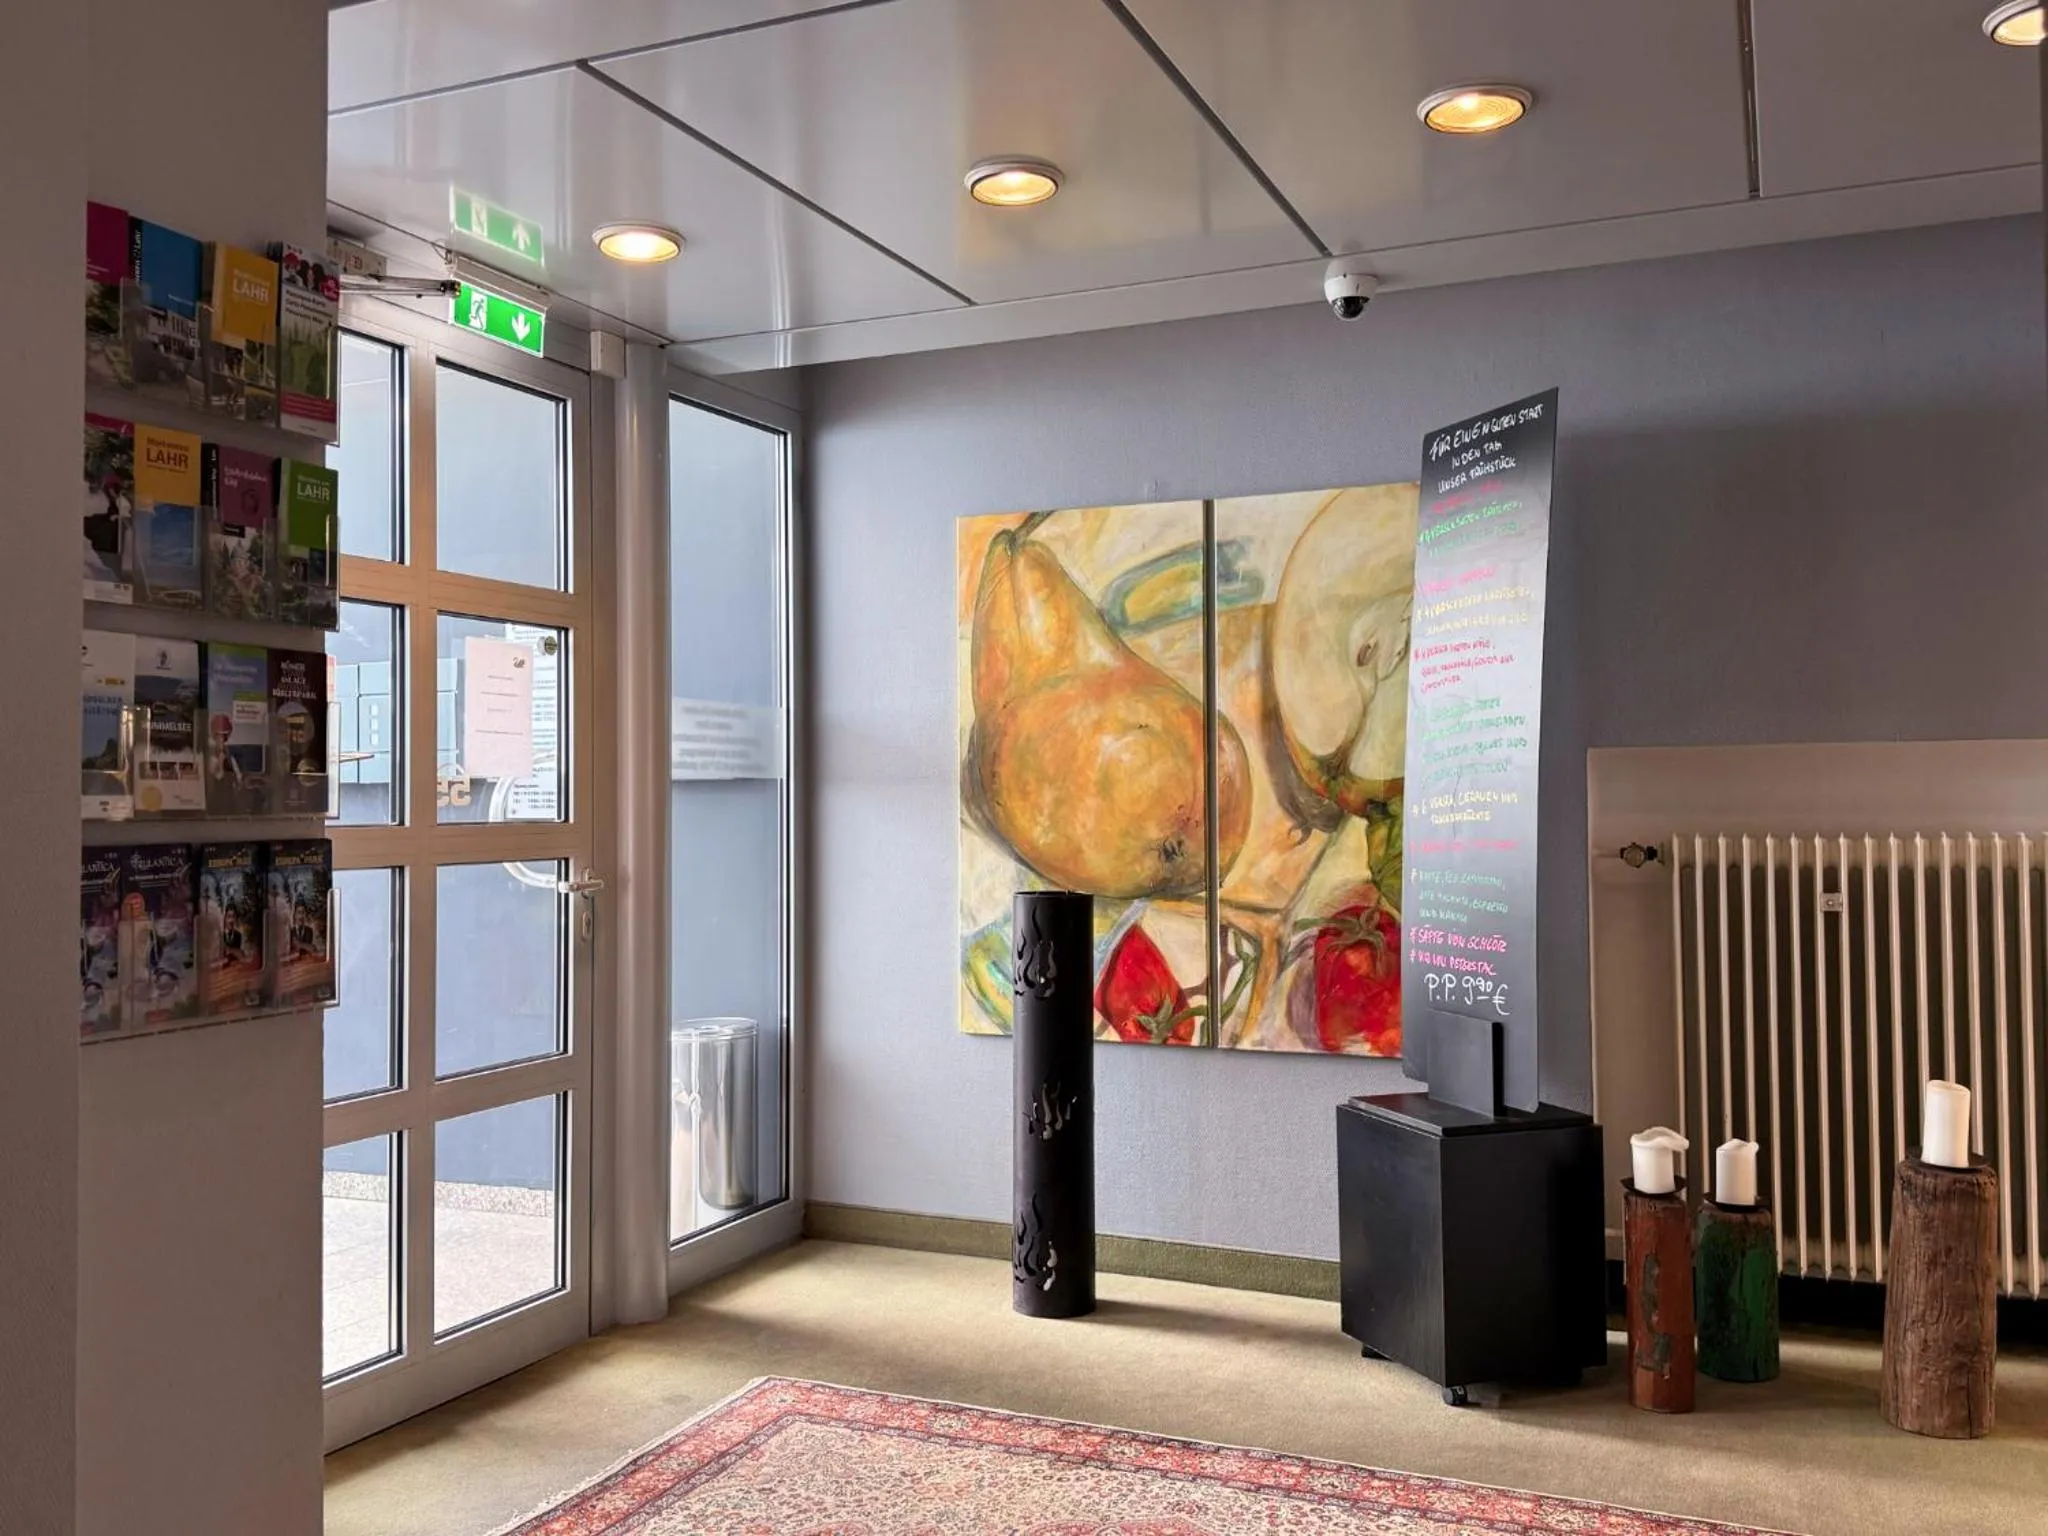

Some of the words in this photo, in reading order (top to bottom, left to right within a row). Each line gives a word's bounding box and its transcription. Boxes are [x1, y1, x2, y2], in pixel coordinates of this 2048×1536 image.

[232, 277, 269, 303] LAHR
[1429, 433, 1451, 461] FÜR
[1453, 422, 1490, 448] EINEN
[1490, 413, 1516, 432] GUTEN
[1518, 403, 1544, 424] START
[146, 447, 188, 469] LAHR
[1461, 448, 1481, 466] DEN
[1483, 440, 1502, 455] TAG
[1438, 472, 1467, 494] UNSER
[1469, 455, 1517, 479] FRÜHSTÜCK
[297, 482, 330, 501] LAHR
